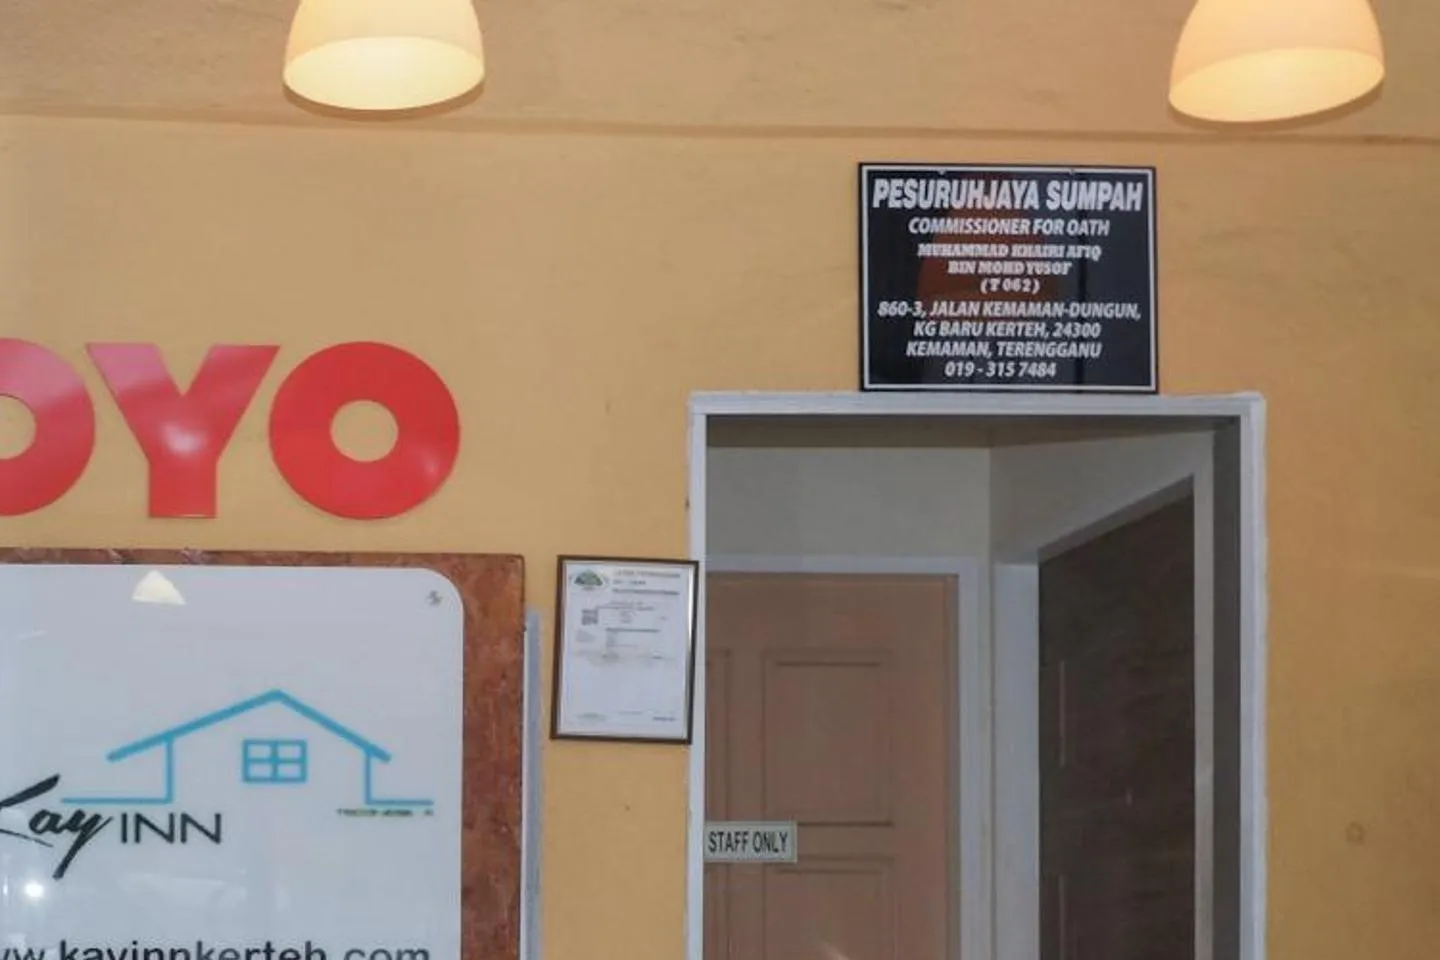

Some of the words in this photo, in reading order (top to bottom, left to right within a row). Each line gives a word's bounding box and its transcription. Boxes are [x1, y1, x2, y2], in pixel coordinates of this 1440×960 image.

[872, 178, 1040, 210] PESURUHJAYA
[1046, 181, 1143, 211] SUMPAH
[908, 216, 1030, 235] COMMISSIONER
[1032, 217, 1064, 236] FOR
[1066, 218, 1110, 236] OATH
[917, 243, 1009, 258] MUHAMMAD
[948, 260, 976, 275] BIN
[977, 260, 1025, 275] MOHD
[1026, 260, 1072, 275] YUSOF
[877, 301, 927, 319] 860-3,
[929, 302, 981, 318] JALAN
[982, 302, 1141, 320] KEMAMAN-DUNGUN,
[913, 320, 936, 337] KG
[938, 321, 984, 337] BARU
[985, 321, 1050, 339] KERTEH,
[1053, 322, 1101, 338] 24300
[906, 341, 993, 359] KEMAMAN,
[996, 341, 1102, 358] TERENGGANU
[944, 361, 974, 377] 019
[986, 362, 1015, 377] 315
[1016, 362, 1057, 377] 7484
[119, 812, 222, 845] INN
[708, 830, 749, 853] STAFF
[752, 830, 788, 854] ONLY
